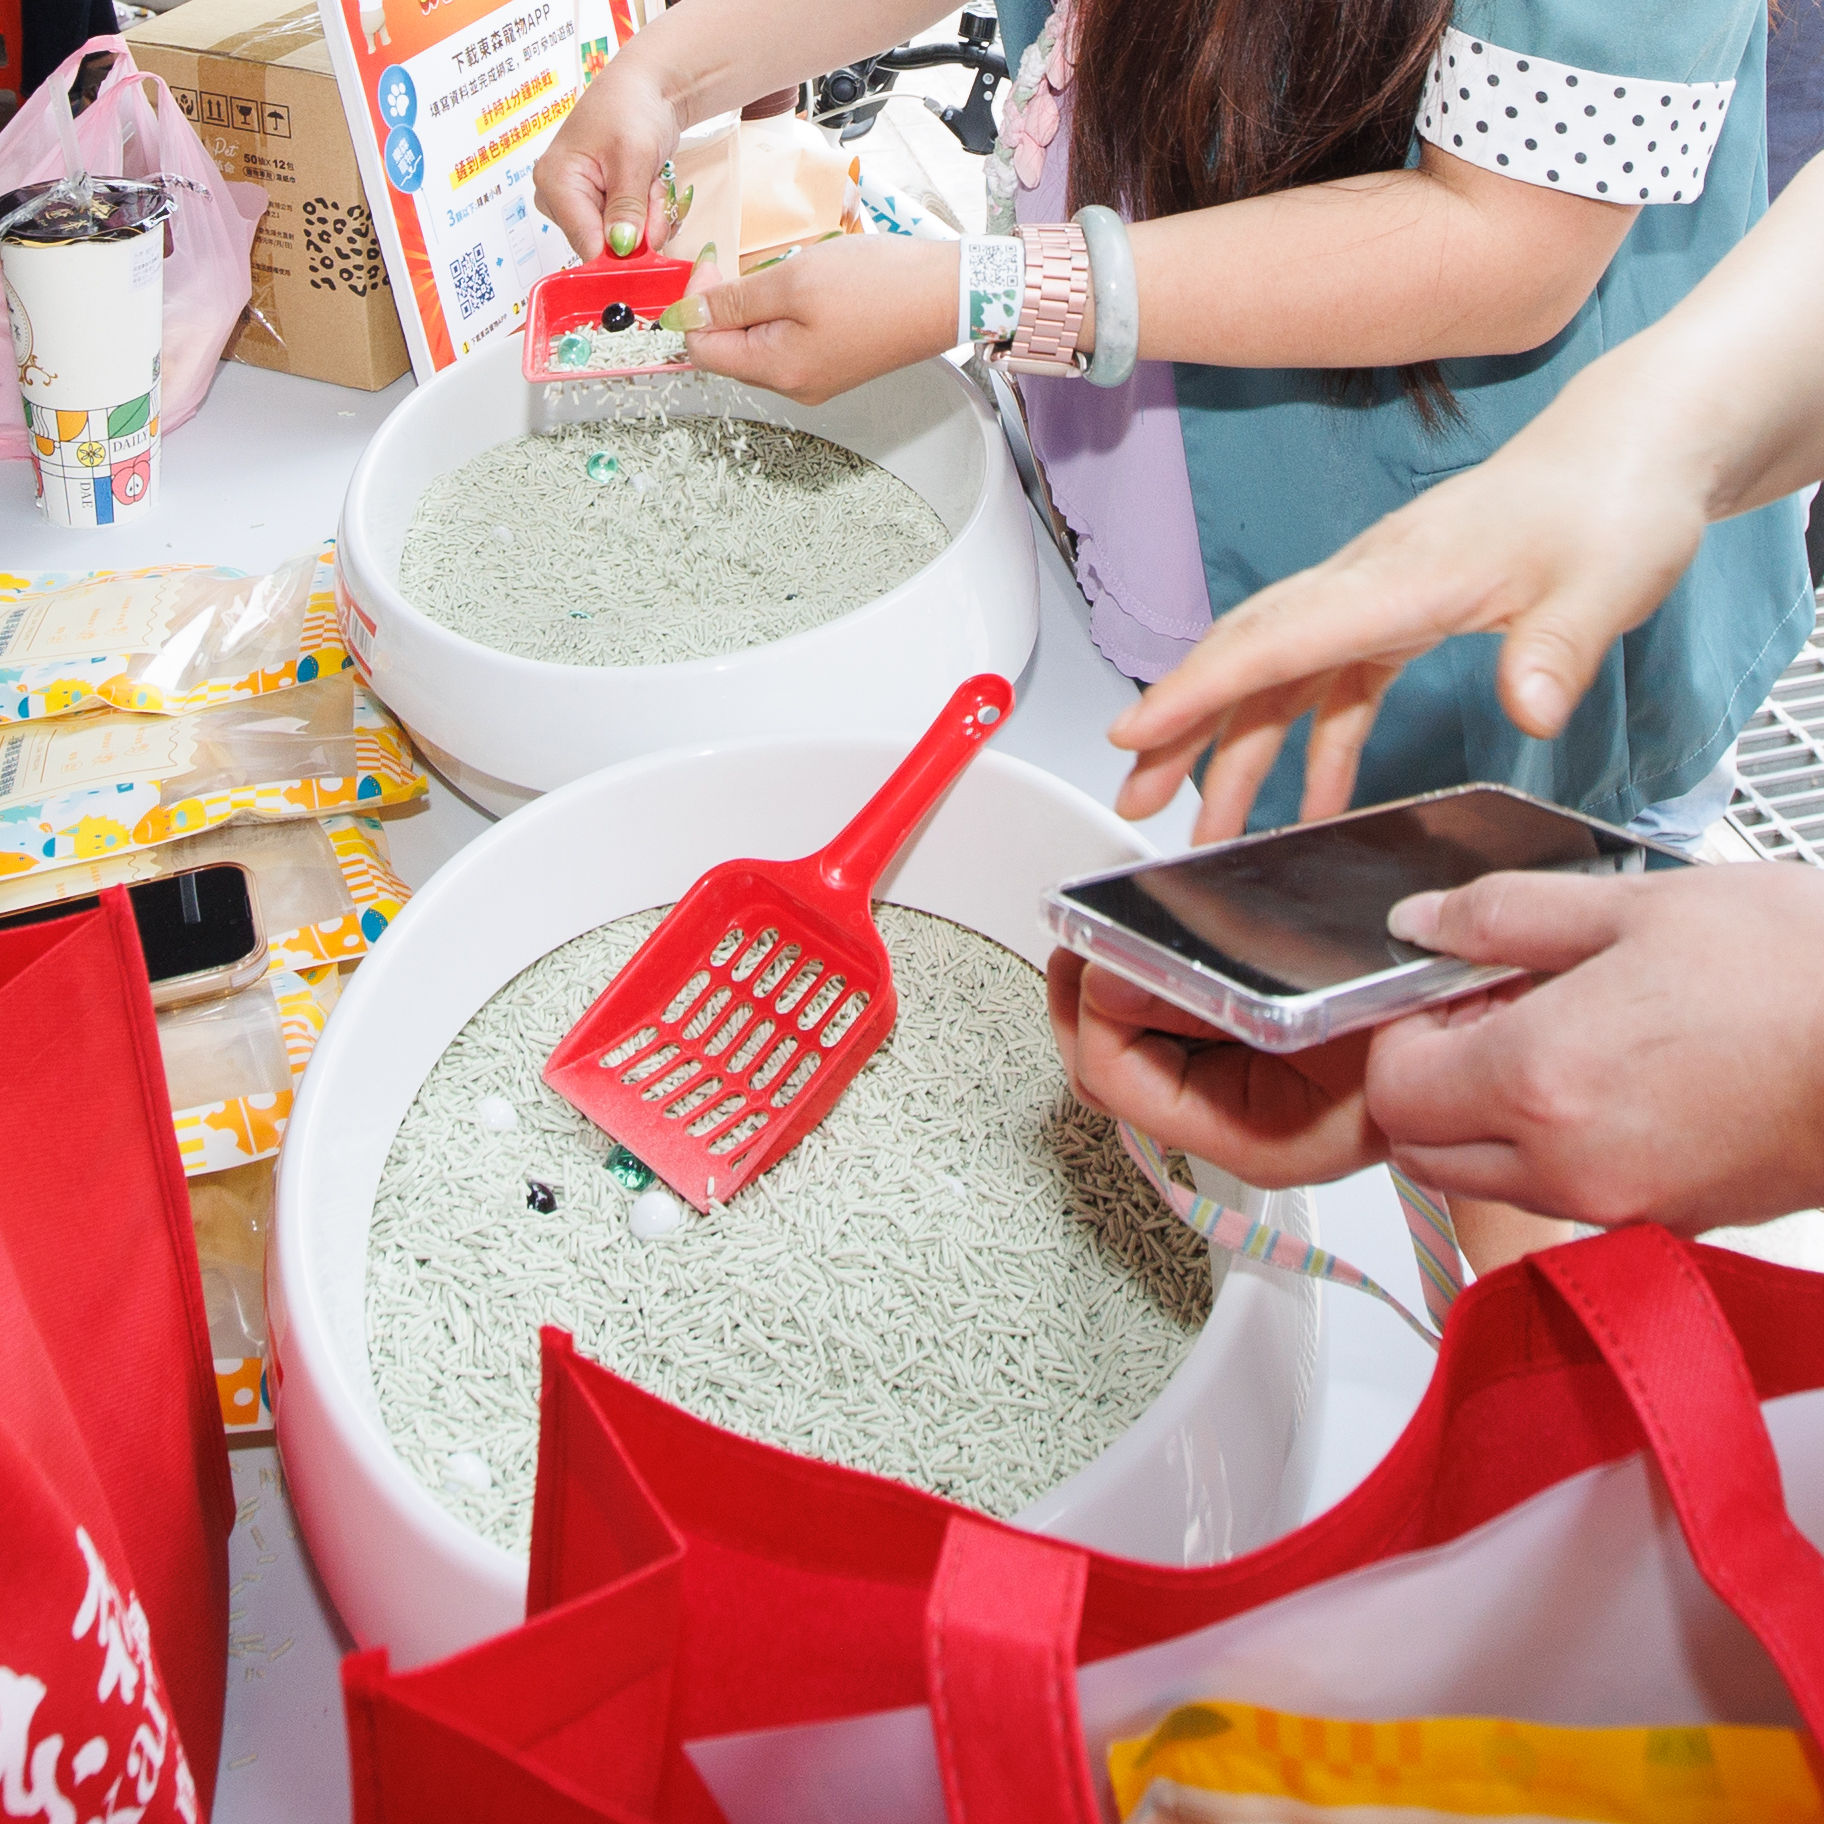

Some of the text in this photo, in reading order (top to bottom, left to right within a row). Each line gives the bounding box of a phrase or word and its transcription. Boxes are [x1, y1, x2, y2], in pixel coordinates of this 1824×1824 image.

[451, 3, 551, 74] 下載東森寵物APP
[480, 68, 554, 127] 計時1分鐘挑戰
[112, 428, 149, 453] DAILY
